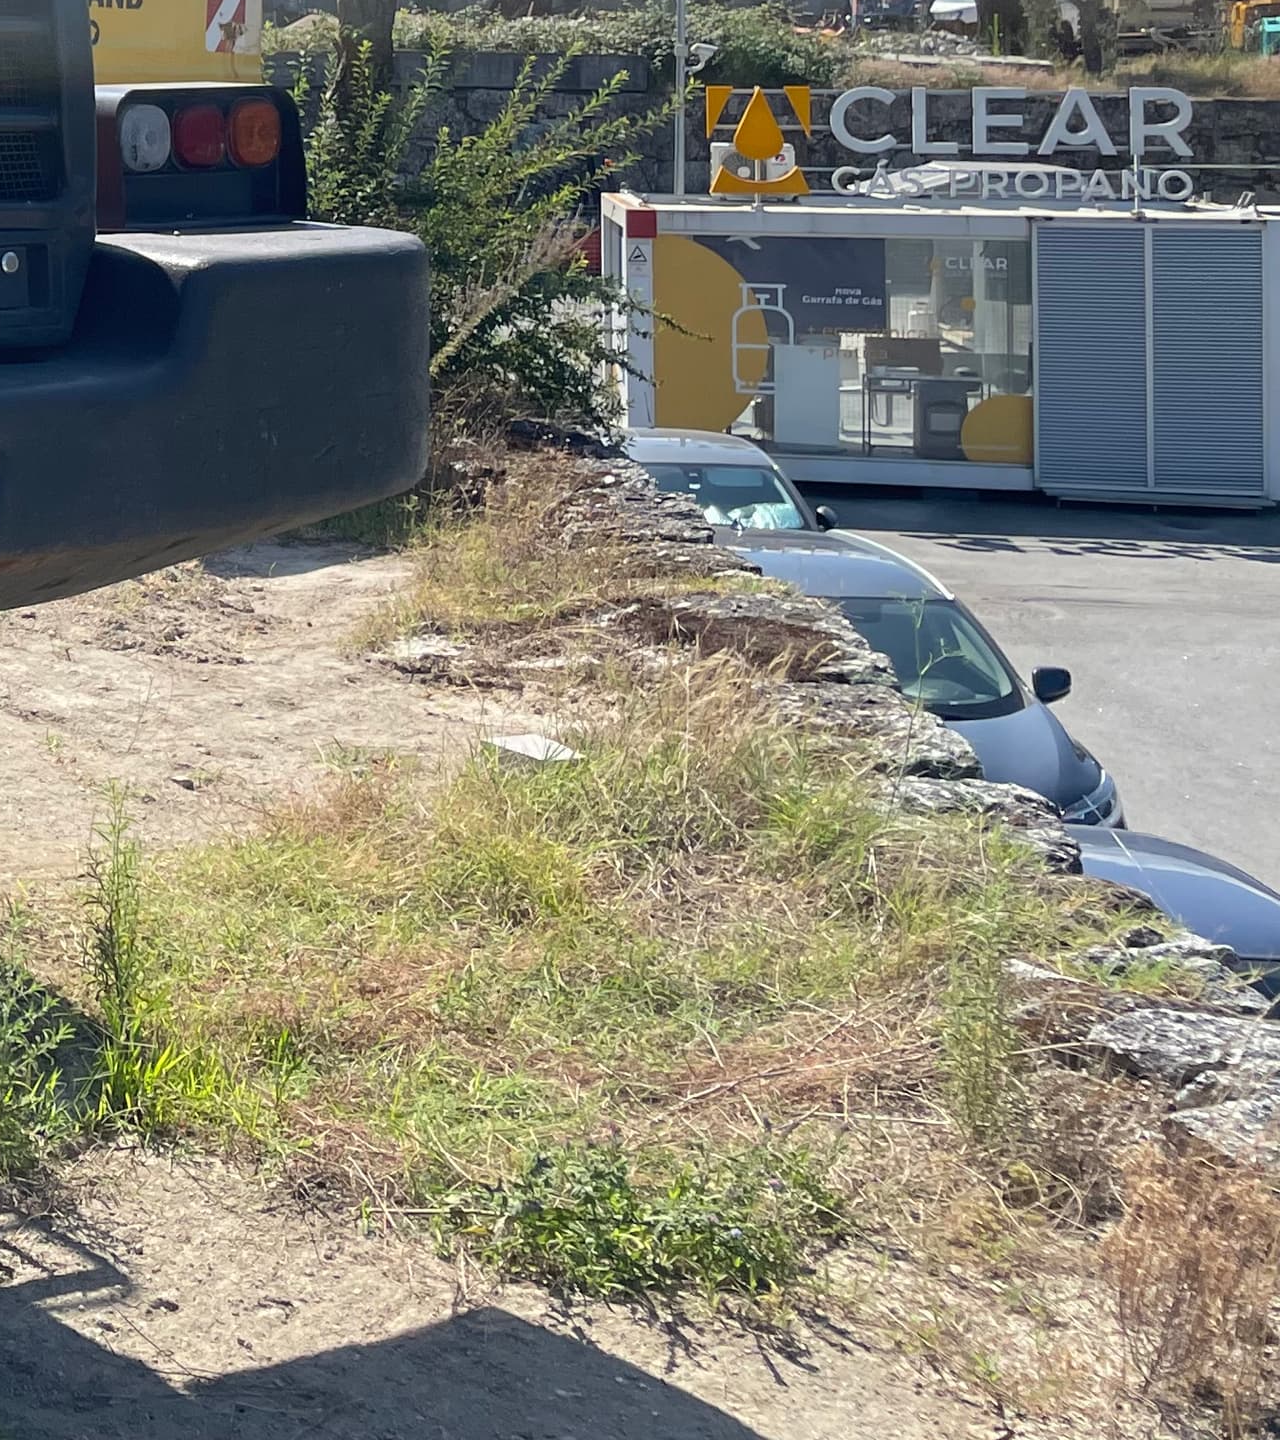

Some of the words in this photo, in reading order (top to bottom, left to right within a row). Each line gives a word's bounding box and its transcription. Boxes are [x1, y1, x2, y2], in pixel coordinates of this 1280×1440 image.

[829, 86, 1195, 157] CLEAR
[831, 159, 926, 198] GÁS
[950, 168, 1194, 202] PROPANO
